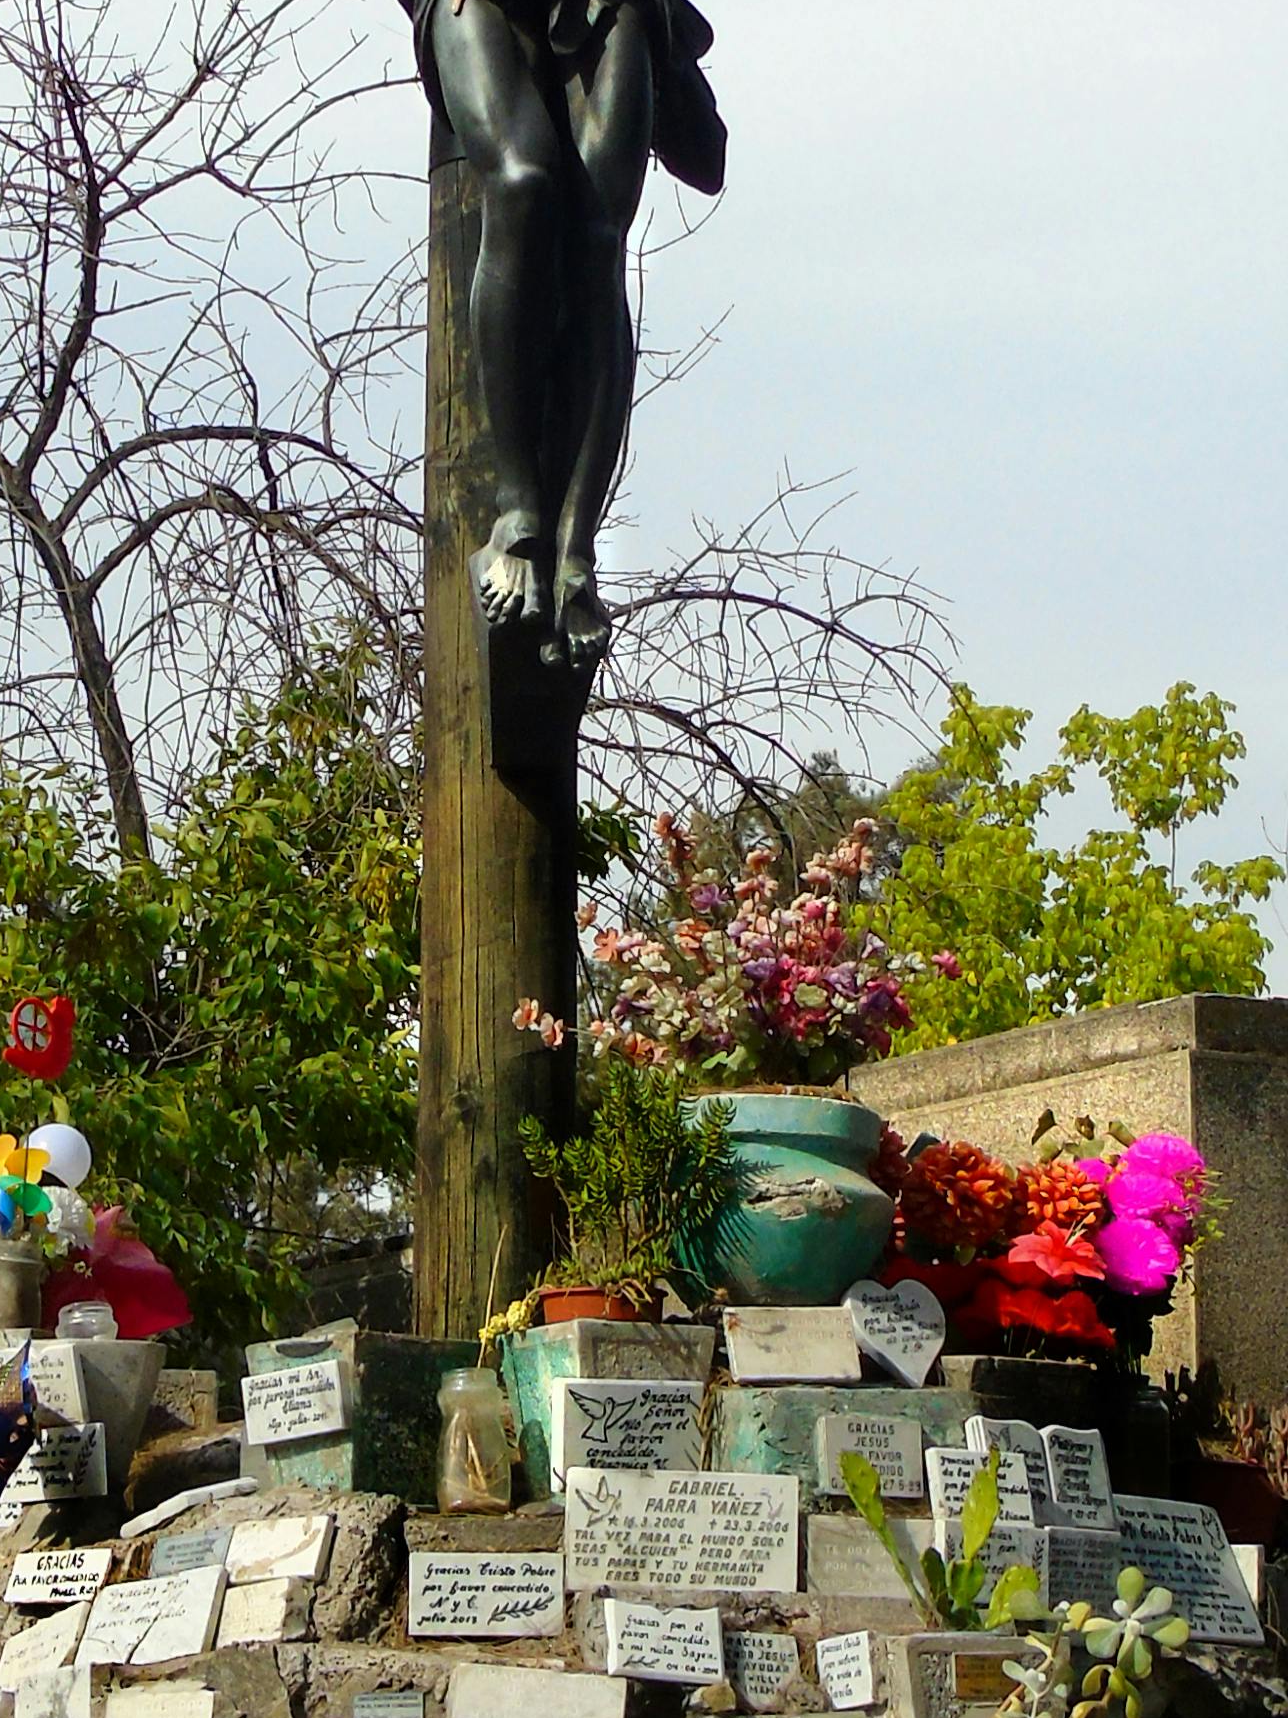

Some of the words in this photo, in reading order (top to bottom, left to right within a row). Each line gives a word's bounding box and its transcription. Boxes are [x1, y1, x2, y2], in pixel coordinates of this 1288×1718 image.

[639, 1388, 692, 1408] Gracias
[644, 1407, 685, 1420] Señor
[650, 1420, 671, 1434] por
[676, 1414, 690, 1430] el
[847, 1422, 894, 1434] GRACIAS
[620, 1434, 664, 1451] favor
[854, 1437, 890, 1448] JESUS
[868, 1452, 902, 1462] FAVOR
[645, 1498, 697, 1514] PARRA
[711, 1496, 763, 1516] YAÑEZ
[574, 1529, 596, 1540] TAL
[605, 1532, 631, 1542] VEZ
[638, 1533, 671, 1544] PARA
[678, 1534, 694, 1545] EL
[701, 1535, 745, 1546] MUNDO
[751, 1537, 784, 1548] SOLO
[572, 1543, 607, 1554] SEAS
[699, 1547, 732, 1559] PERO
[739, 1549, 771, 1561] PARA
[36, 1552, 85, 1570] GRACIAS
[574, 1557, 599, 1568] TUS
[607, 1558, 646, 1569] PAPAS
[655, 1560, 663, 1569] Y
[673, 1561, 688, 1571] TU
[695, 1562, 764, 1574] HERMANITA
[424, 1563, 471, 1579] Gracias
[478, 1562, 516, 1576] Cristo
[521, 1562, 556, 1576] Pobre
[605, 1571, 639, 1582] ERES
[649, 1572, 682, 1583] TODO
[689, 1573, 707, 1585] SU
[714, 1574, 757, 1586] MUNDO
[422, 1585, 443, 1595] por
[449, 1581, 486, 1595] favor
[451, 1600, 461, 1612] y
[417, 1612, 447, 1626] julio
[450, 1615, 477, 1624] 2013
[626, 1614, 660, 1629] Gracias
[670, 1621, 686, 1632] por
[620, 1629, 650, 1642] favor
[662, 1633, 710, 1646] concedido
[630, 1644, 644, 1653] mi
